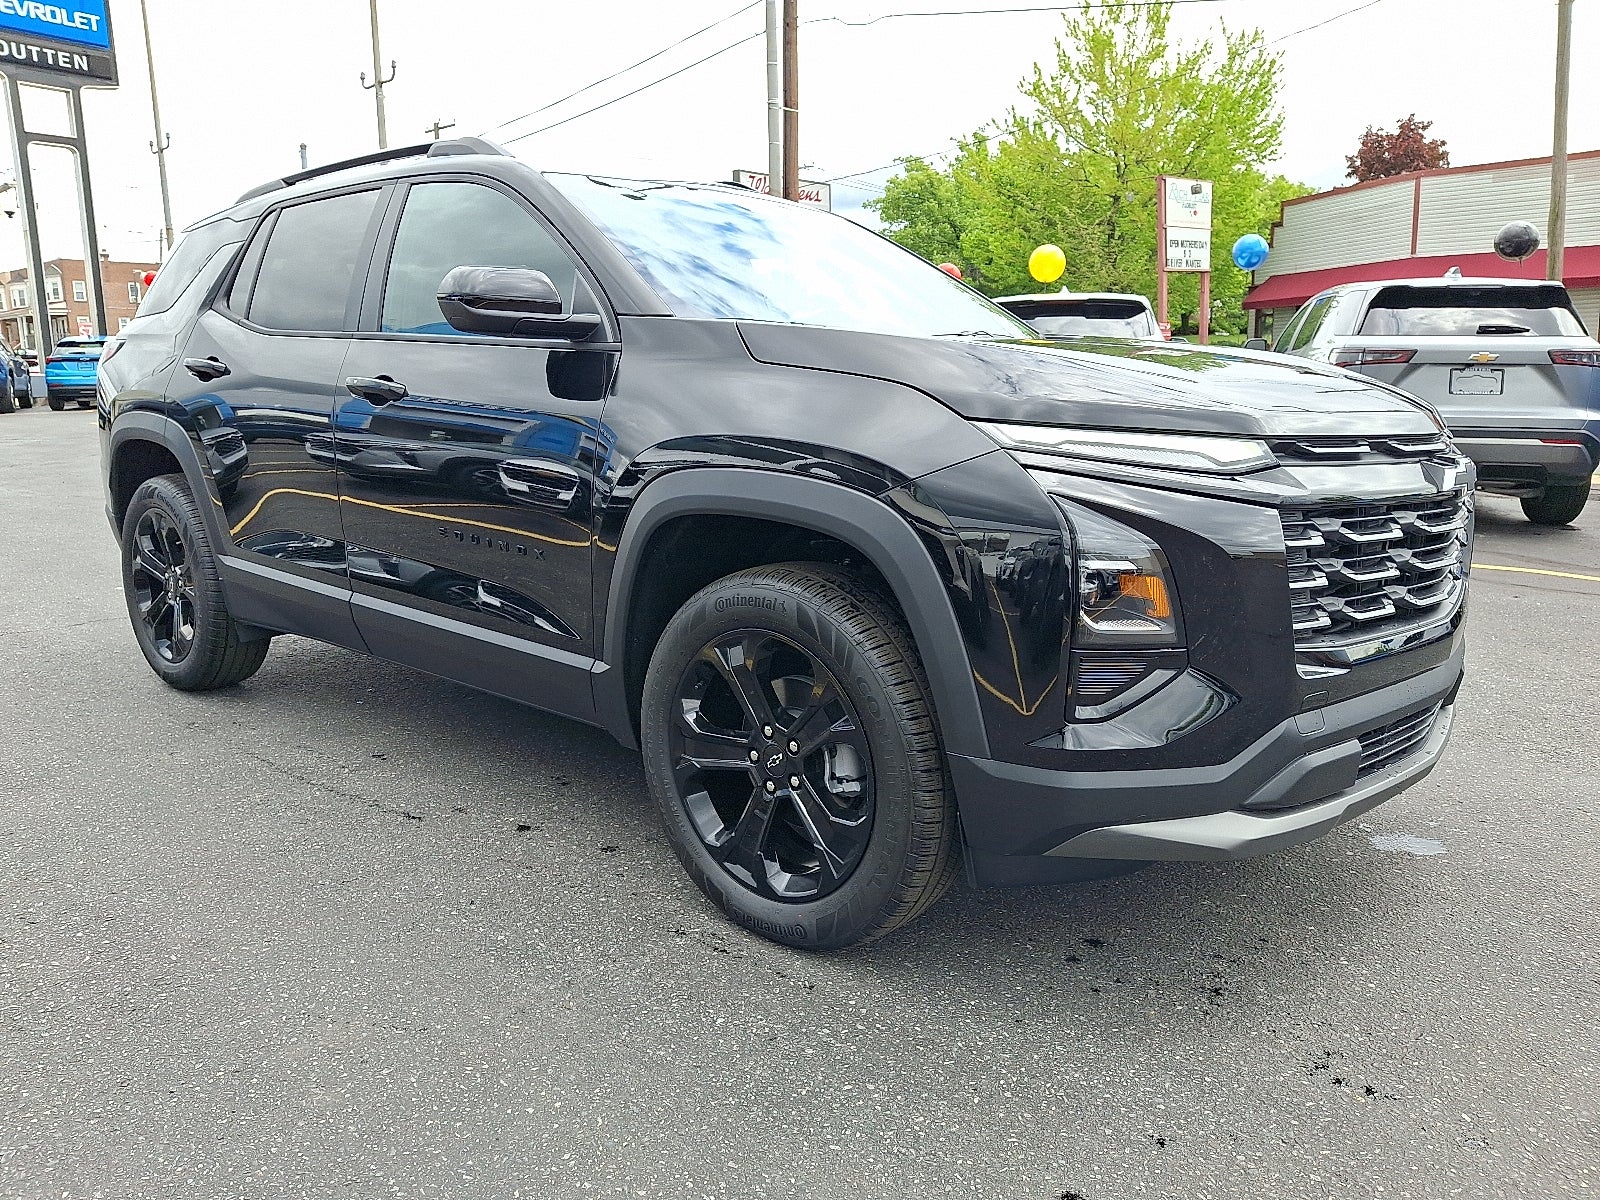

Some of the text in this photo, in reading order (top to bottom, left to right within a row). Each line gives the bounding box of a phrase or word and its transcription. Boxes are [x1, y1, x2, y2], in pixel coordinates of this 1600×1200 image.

[0, 39, 88, 71] OUTTEN
[438, 526, 546, 561] EQUINOX
[715, 593, 777, 612] Continental
